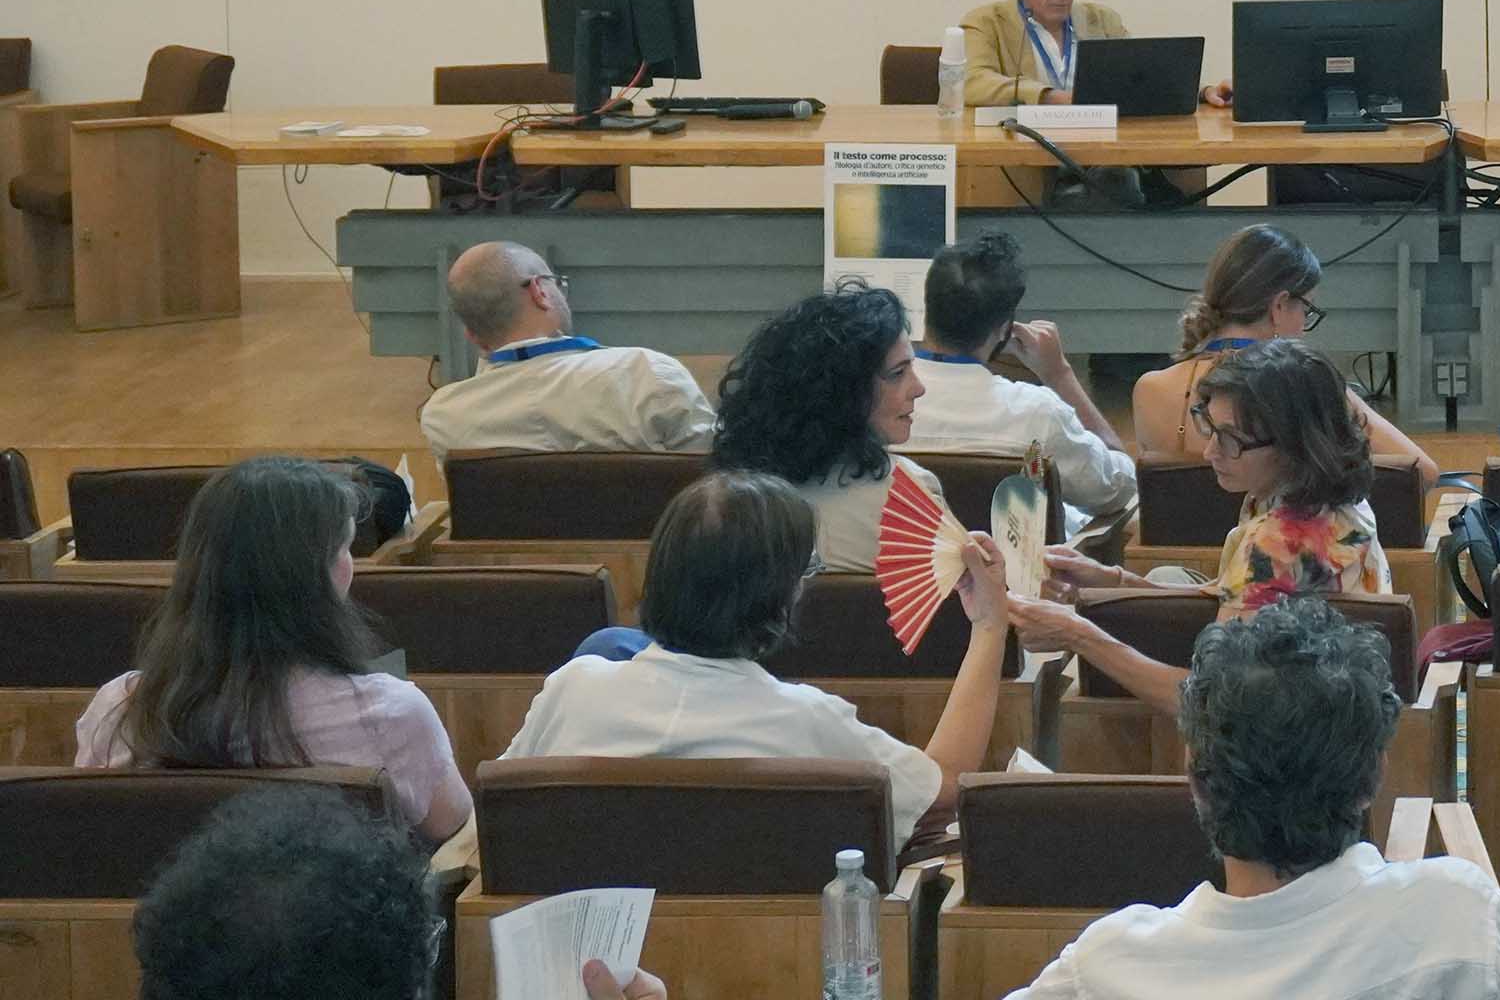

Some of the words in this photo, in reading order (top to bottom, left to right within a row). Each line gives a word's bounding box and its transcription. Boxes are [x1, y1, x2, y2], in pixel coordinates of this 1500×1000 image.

[834, 152, 840, 160] Il
[842, 152, 867, 160] testo
[899, 153, 947, 162] processo:
